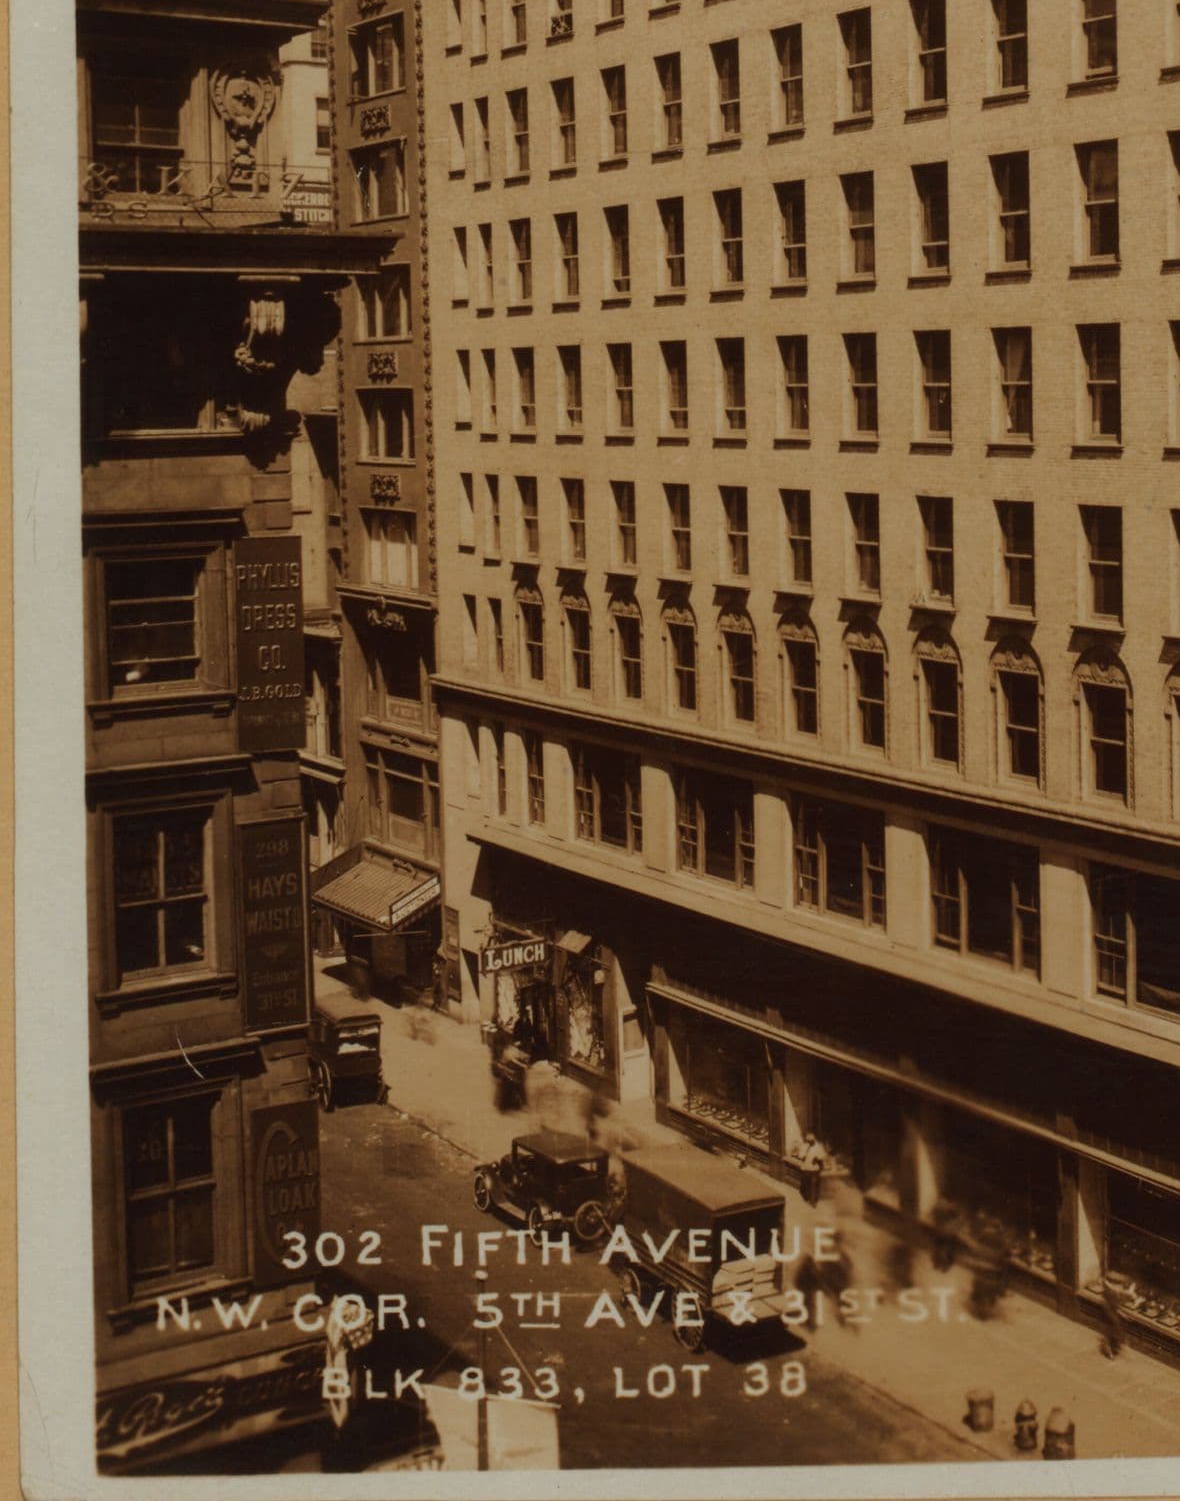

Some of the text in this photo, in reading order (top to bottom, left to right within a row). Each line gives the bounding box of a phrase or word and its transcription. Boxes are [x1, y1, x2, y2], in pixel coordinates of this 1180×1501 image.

[155, 165, 305, 200] KATZ
[236, 563, 300, 590] PHYLLIS
[241, 603, 296, 631] DRESS
[258, 645, 287, 670] CO.
[247, 872, 297, 901] HAYS
[485, 943, 546, 971] LUNCH
